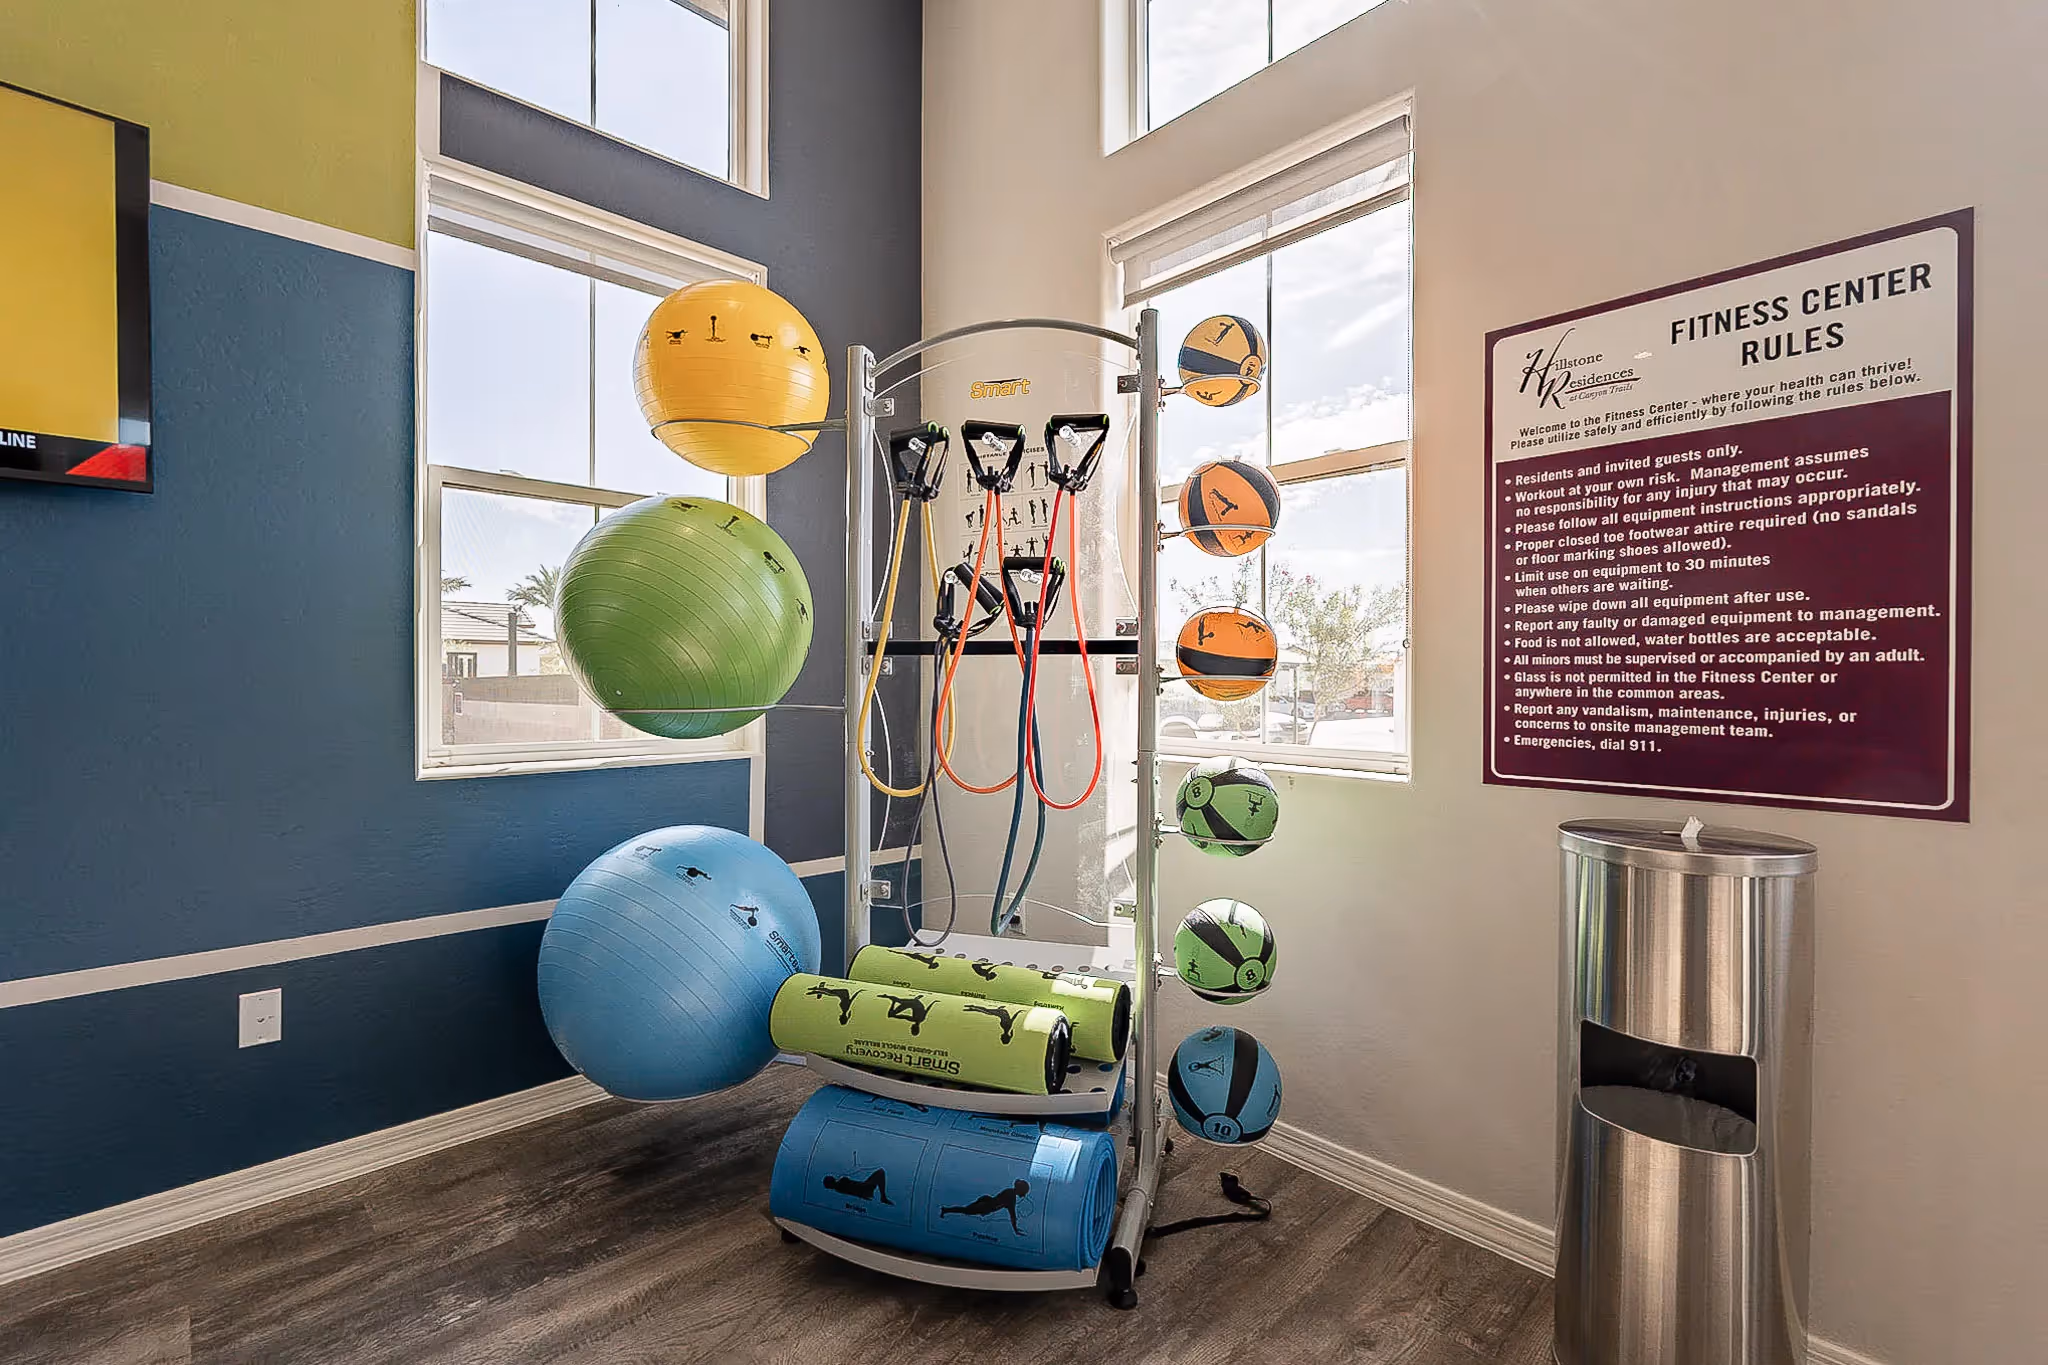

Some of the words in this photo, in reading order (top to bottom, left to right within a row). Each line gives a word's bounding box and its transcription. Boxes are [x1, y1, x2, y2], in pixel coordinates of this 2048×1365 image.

[1670, 295, 1789, 345] FITNESS
[1801, 262, 1932, 315] CENTER
[1741, 321, 1844, 367] RULES
[1519, 328, 1603, 397] Hillstone
[970, 378, 1031, 399] Smart
[1519, 422, 1567, 438] Welcome
[1569, 419, 1581, 429] to
[1583, 415, 1601, 427] the
[1604, 408, 1645, 423] Fitness
[1648, 400, 1689, 415] Center
[1700, 390, 1741, 406] where
[1744, 384, 1775, 400] your
[1779, 374, 1824, 392] health
[1829, 369, 1856, 383] can
[1861, 357, 1912, 377] thrive!
[1539, 369, 1634, 409] Residences
[1510, 437, 1544, 450] Please
[1547, 430, 1581, 444] utilize
[1583, 423, 1618, 438] safely
[1620, 418, 1642, 432] and
[1645, 408, 1708, 427] efficiently
[1711, 405, 1727, 417] by
[1730, 394, 1794, 413] following
[1798, 389, 1821, 402] the
[1826, 382, 1864, 397] rules
[1869, 372, 1921, 390] below.
[1514, 486, 1566, 503] Workout
[1567, 484, 1581, 496] at
[1584, 481, 1614, 497] your
[1616, 477, 1644, 490] own
[1648, 471, 1680, 486] risk.
[1690, 455, 1790, 480] Management
[1794, 447, 1869, 467] assumes
[1515, 468, 1574, 486] Residents
[1576, 462, 1601, 477] and
[1605, 455, 1651, 473] invited
[1654, 449, 1702, 469] guests
[1706, 443, 1743, 458] only.
[1514, 521, 1555, 535] Please
[1558, 516, 1598, 530] follow
[1601, 512, 1619, 525] all
[1622, 504, 1696, 525] equipment
[1700, 495, 1793, 515] instructions
[1797, 479, 1921, 506] appropriately.
[1515, 506, 1531, 517] no
[1533, 494, 1620, 515] responsibility
[1622, 492, 1642, 505] for
[1645, 489, 1671, 503] any
[1675, 483, 1718, 500] injury
[1721, 477, 1752, 493] that
[1757, 474, 1790, 489] may
[1795, 468, 1848, 484] occur.
[1514, 538, 1555, 553] Proper
[1557, 532, 1600, 548] closed
[1603, 532, 1625, 543] toe
[1628, 525, 1690, 541] footwear
[1693, 519, 1734, 535] attire
[1738, 511, 1807, 531] required
[1812, 509, 1841, 525] (no
[1846, 501, 1917, 520] sandals
[1515, 556, 1529, 566] or
[1530, 552, 1561, 565] floor
[1562, 547, 1616, 562] marking
[1618, 544, 1659, 558] shoes
[1662, 535, 1732, 554] allowed).
[1514, 569, 1545, 583] Limit
[1547, 570, 1569, 581] use
[1572, 568, 1589, 579] on
[1592, 561, 1663, 579] equipment
[1665, 560, 1680, 573] to
[1684, 557, 1705, 571] 30
[1709, 554, 1771, 569] minutes
[1514, 585, 1547, 597] when
[1550, 583, 1590, 595] others
[1592, 582, 1615, 593] are
[1618, 577, 1673, 591] waiting.
[1514, 602, 1555, 614] Please
[1557, 599, 1589, 614] wipe
[1591, 598, 1627, 611] down
[1630, 596, 1649, 609] all
[1652, 592, 1729, 610] equipment
[1733, 590, 1771, 604] after
[1775, 590, 1810, 602] use.
[1514, 619, 1554, 633] Report
[1556, 620, 1580, 632] any
[1582, 616, 1619, 631] faulty
[1622, 617, 1638, 628] or
[1641, 612, 1705, 629] damaged
[1710, 609, 1793, 627] equipment
[1797, 609, 1814, 622] to
[1819, 604, 1941, 622] management.
[1514, 636, 1543, 648] Food
[1545, 635, 1558, 648] is
[1560, 636, 1581, 647] not
[1584, 633, 1640, 648] allowed,
[1644, 633, 1685, 645] water
[1688, 631, 1740, 645] bottles
[1744, 632, 1770, 643] are
[1775, 627, 1877, 644] acceptable.
[1512, 654, 1529, 665] All
[1531, 653, 1571, 665] minors
[1573, 653, 1603, 665] must
[1605, 652, 1622, 664] be
[1624, 651, 1696, 667] supervised
[1699, 653, 1715, 664] or
[1718, 649, 1820, 666] accompanied
[1825, 649, 1845, 665] by
[1848, 651, 1870, 662] an
[1874, 647, 1925, 662] adult.
[1513, 671, 1547, 683] Glass
[1550, 670, 1562, 683] is
[1564, 671, 1585, 683] not
[1588, 670, 1651, 685] permitted
[1655, 670, 1670, 683] in
[1673, 670, 1697, 683] the
[1701, 670, 1755, 684] Fitness
[1760, 670, 1815, 683] Center
[1819, 672, 1838, 683] or
[1514, 685, 1573, 700] anywhere
[1576, 685, 1589, 698] in
[1592, 686, 1613, 698] the
[1617, 688, 1674, 699] common
[1678, 689, 1725, 700] areas.
[1513, 702, 1553, 717] Report
[1555, 705, 1579, 718] any
[1581, 704, 1654, 719] vandalism,
[1658, 705, 1758, 722] maintenance,
[1764, 707, 1832, 724] injuries,
[1838, 711, 1857, 723] or
[1514, 719, 1570, 730] concerns
[1572, 719, 1586, 731] to
[1590, 719, 1630, 733] onsite
[1634, 723, 1725, 737] management
[1729, 724, 1773, 738] team.
[1513, 734, 1596, 751] Emergencies,
[1599, 737, 1625, 751] dial
[1629, 739, 1662, 753] 911.
[1192, 786, 1202, 798] 8
[905, 1054, 961, 1075] Smart
[1214, 1121, 1232, 1137] 10
